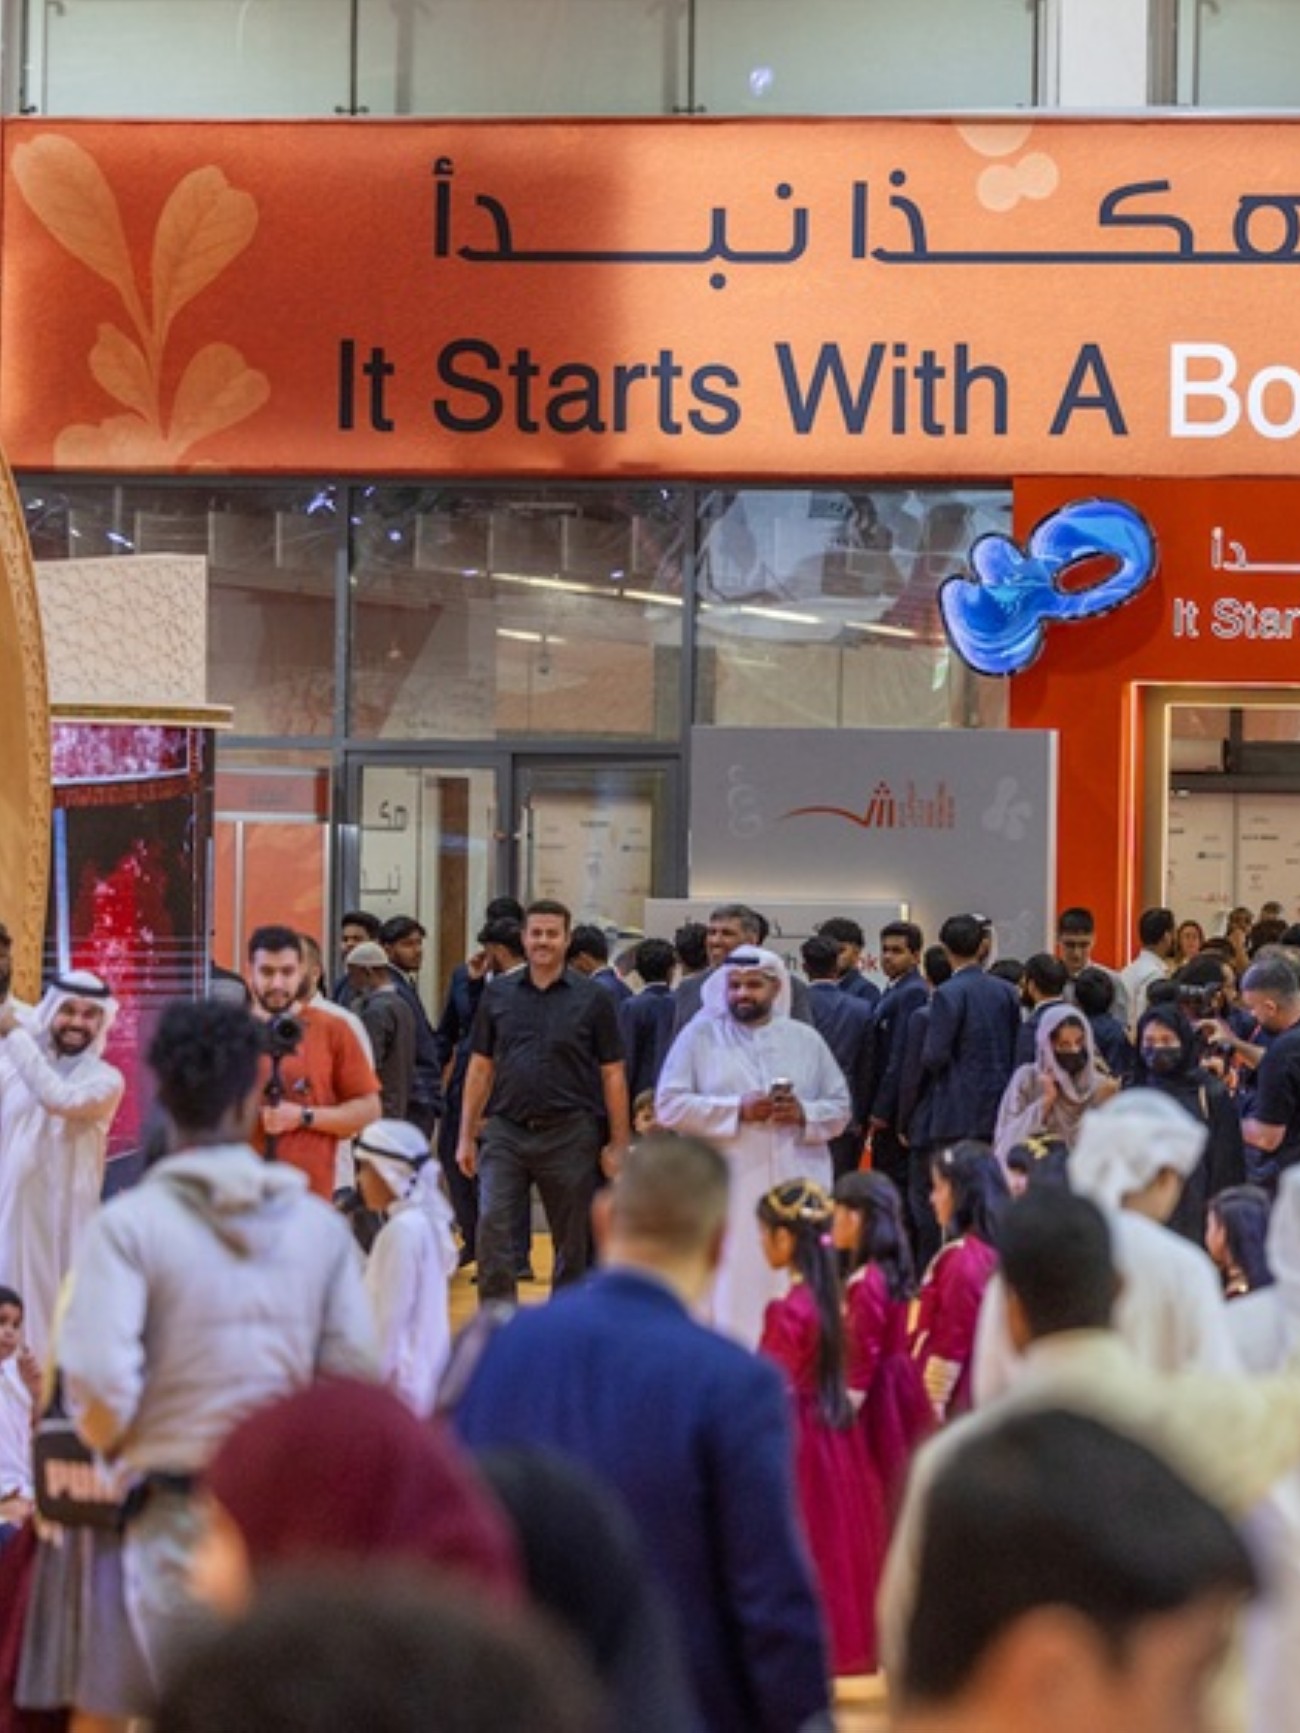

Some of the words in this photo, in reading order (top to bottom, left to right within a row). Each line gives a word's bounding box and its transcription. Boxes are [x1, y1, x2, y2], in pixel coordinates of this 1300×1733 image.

[432, 156, 808, 290] نبدأ
[337, 337, 396, 433] It
[431, 337, 742, 436] Starts
[774, 342, 1009, 436] With
[1049, 343, 1129, 436] A
[1173, 597, 1200, 638] It
